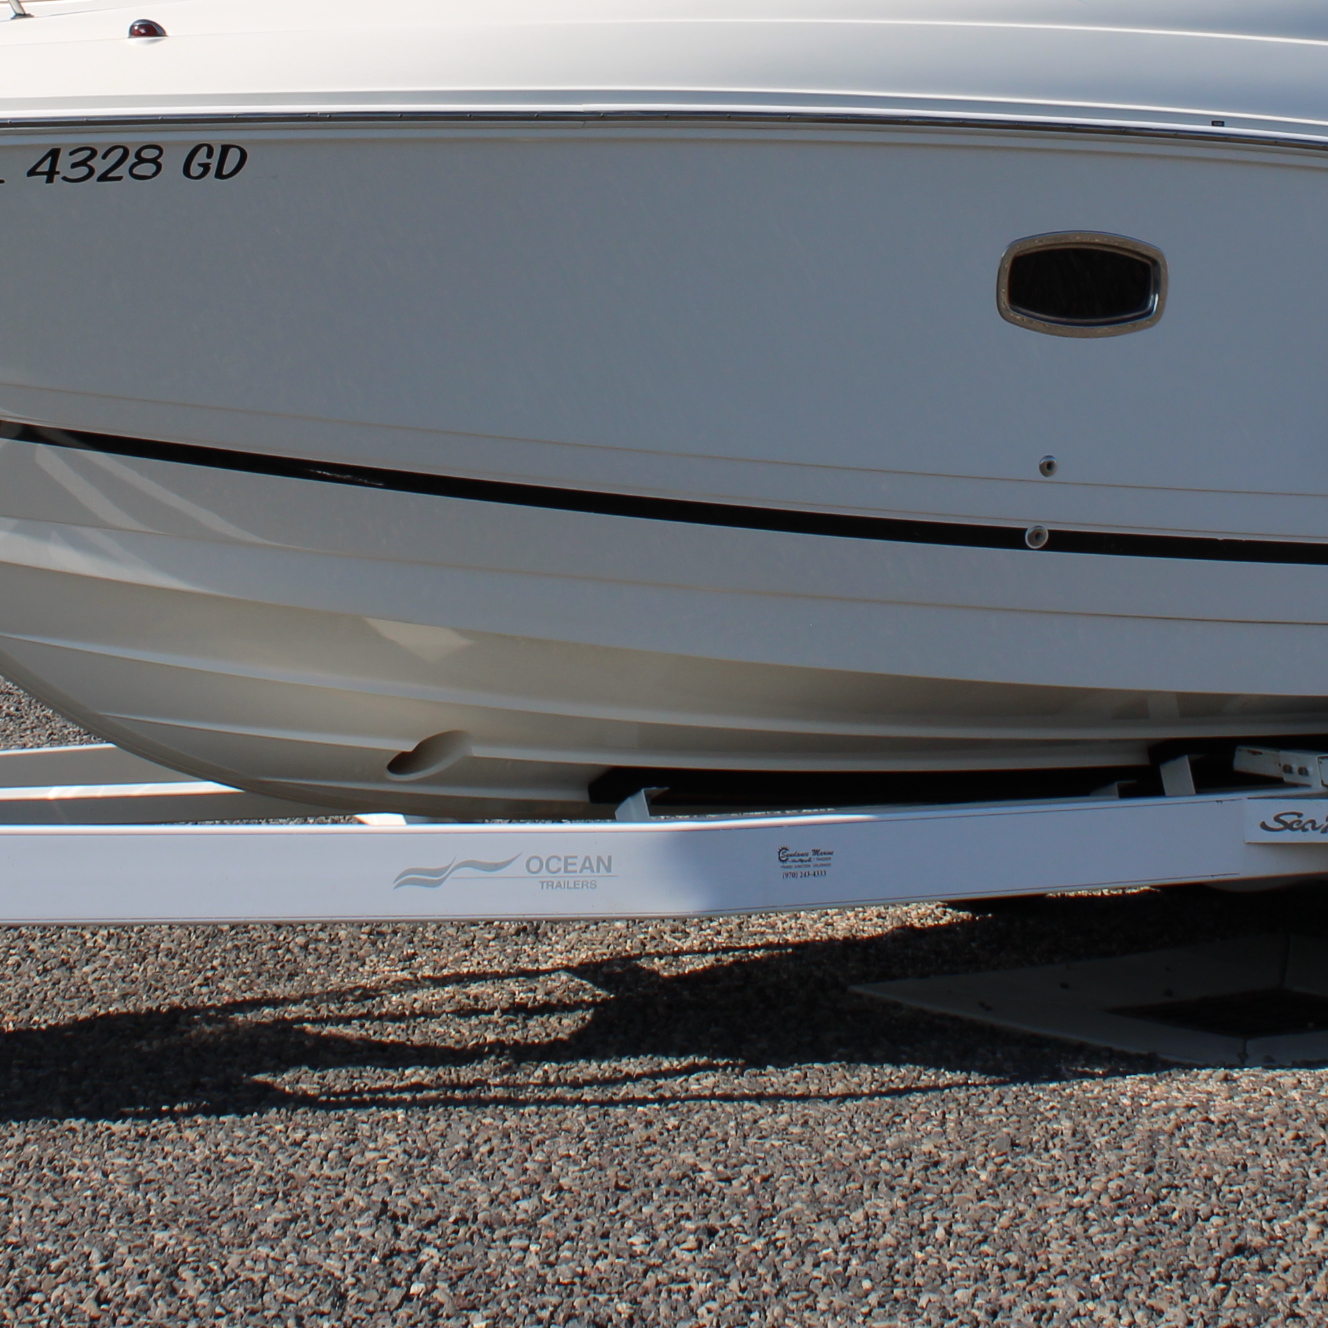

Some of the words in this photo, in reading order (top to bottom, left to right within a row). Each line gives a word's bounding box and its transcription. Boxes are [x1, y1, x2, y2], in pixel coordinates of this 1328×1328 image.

[26, 143, 164, 184] 4328
[182, 143, 249, 180] GD
[1260, 811, 1323, 833] Sea
[525, 855, 612, 875] OCEAN
[538, 880, 598, 890] TRAILERS
